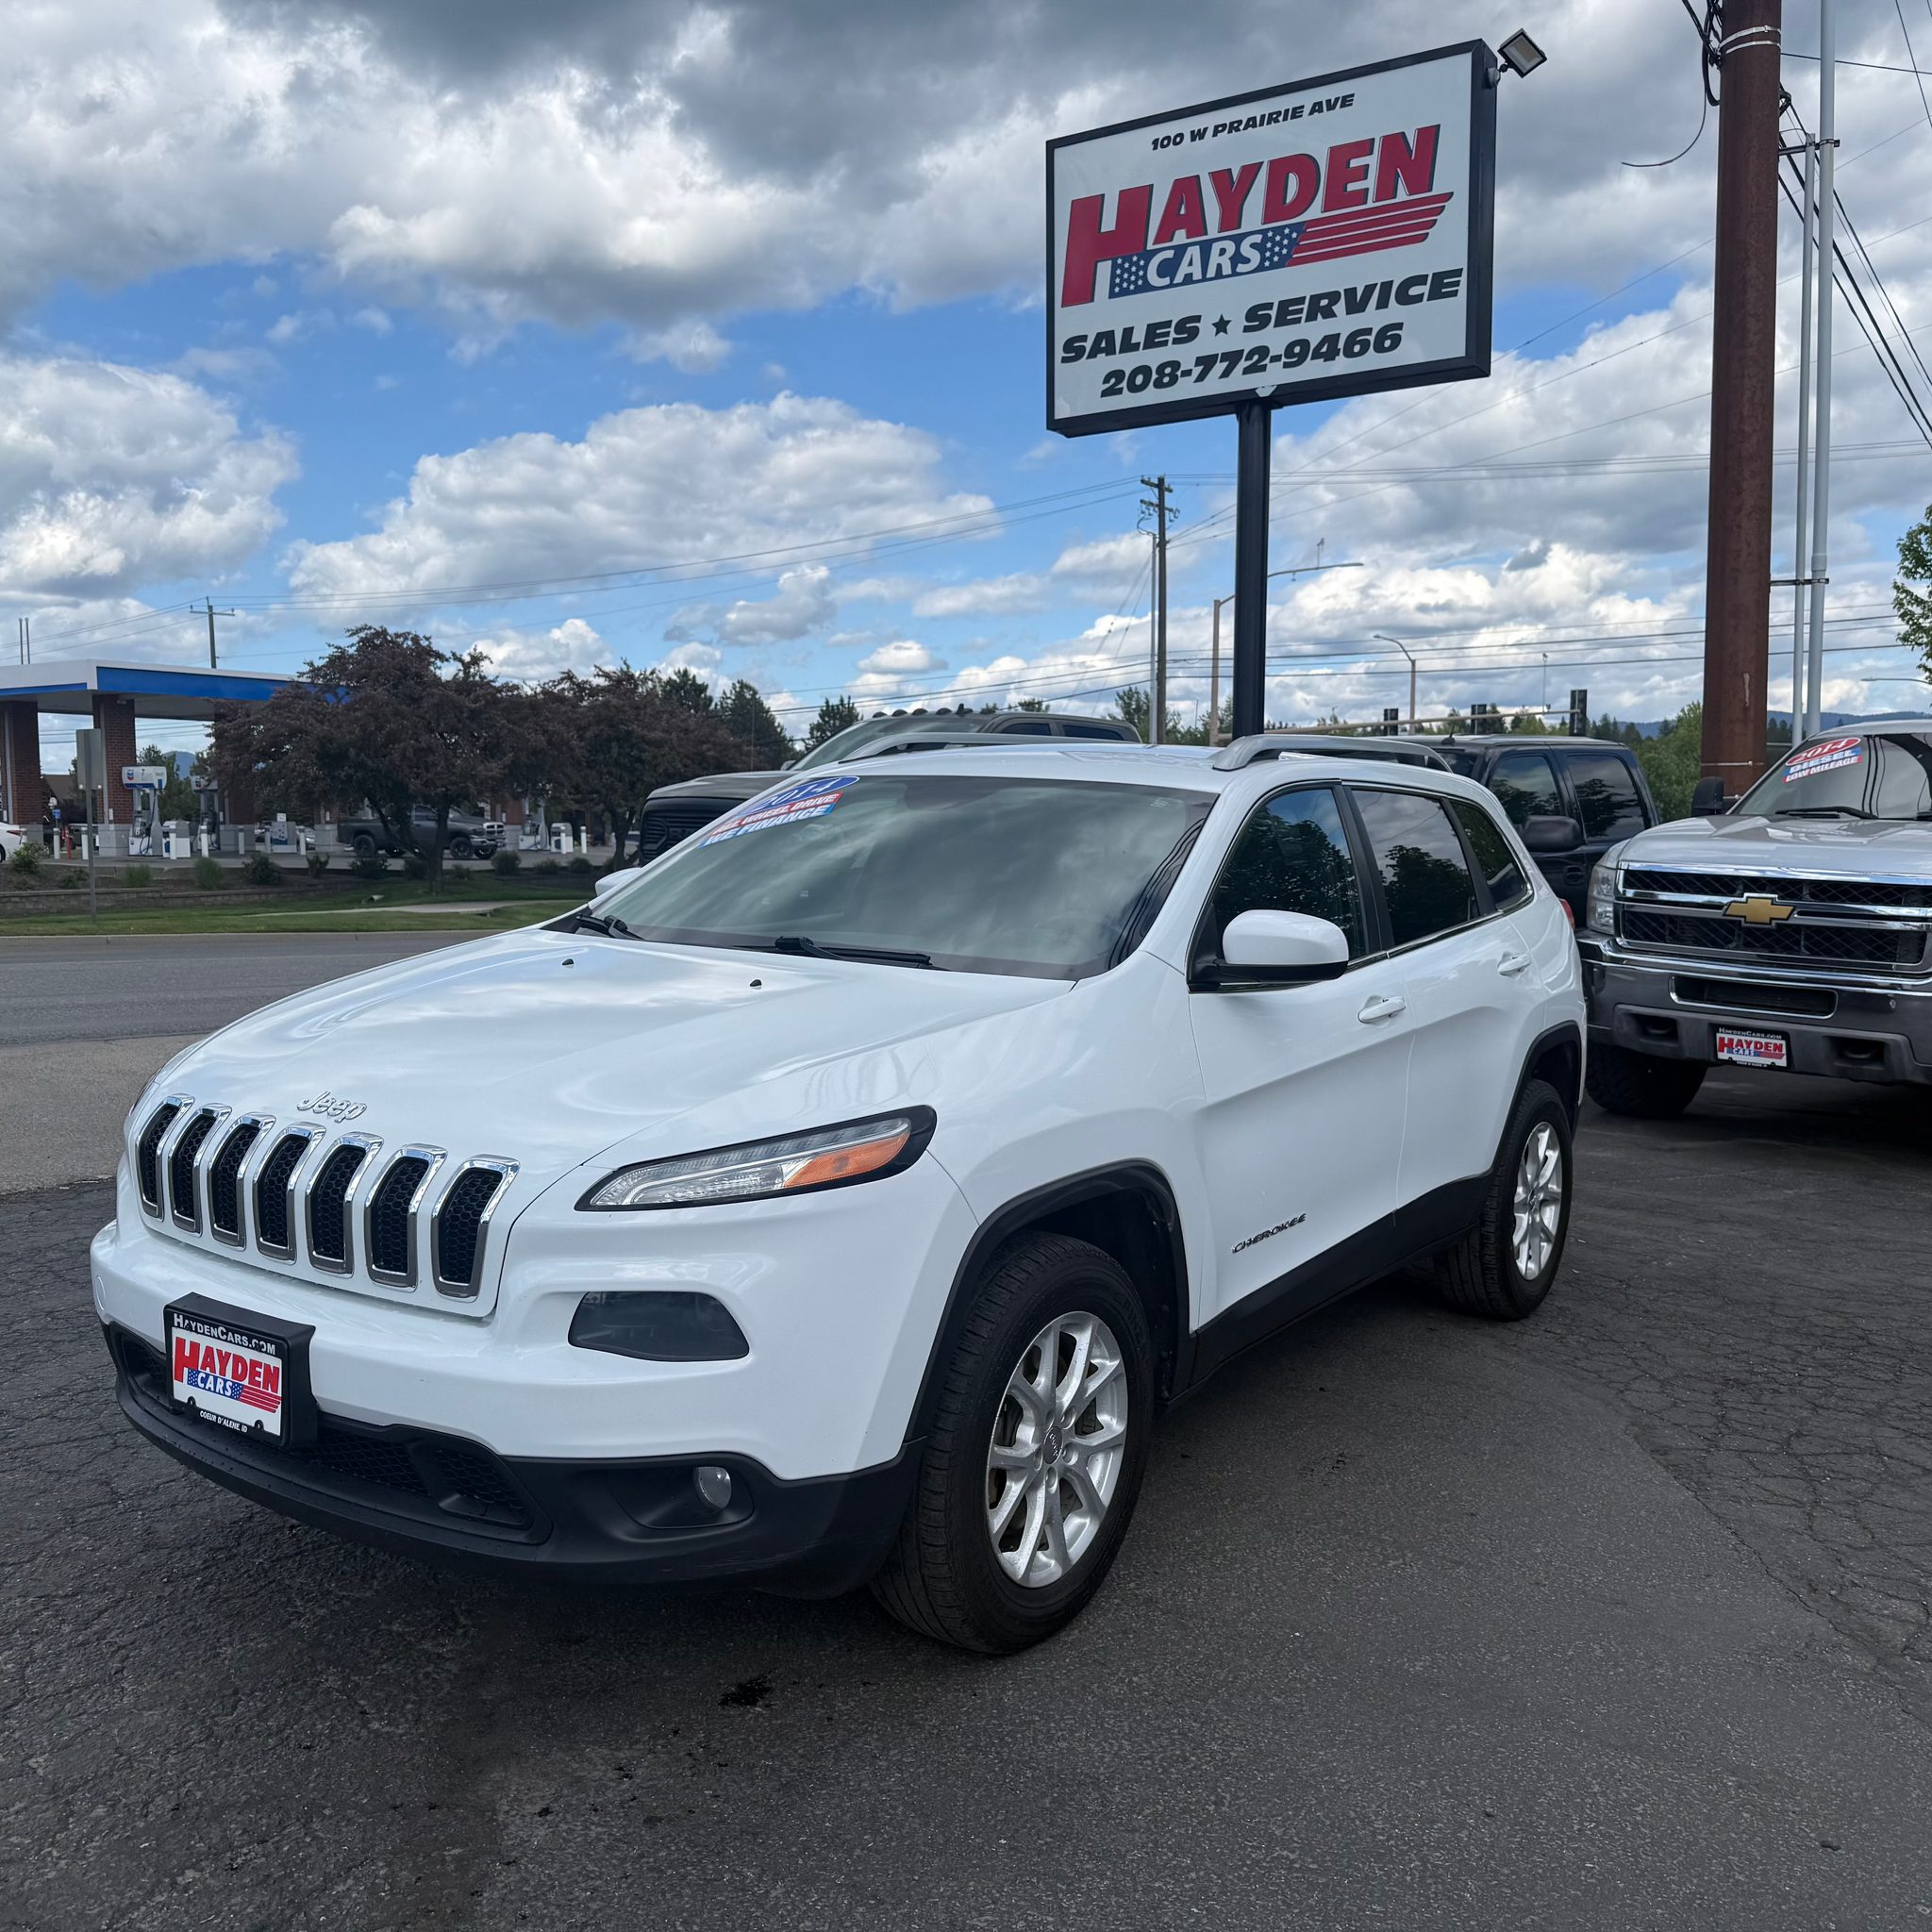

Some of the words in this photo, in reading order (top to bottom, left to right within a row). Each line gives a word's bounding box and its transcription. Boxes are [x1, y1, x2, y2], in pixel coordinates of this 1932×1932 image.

[1151, 130, 1185, 151] 100
[1189, 125, 1209, 142] W
[1212, 105, 1307, 138] PRAIRIE
[1308, 93, 1356, 116] AVE
[1061, 124, 1441, 308] HAYDEN
[1146, 233, 1264, 288] CARS
[1060, 314, 1202, 364] SALES
[1242, 268, 1464, 334] SERVICE
[1100, 322, 1404, 398] 208-772-9466
[1789, 749, 1857, 774] DIESEL
[1793, 739, 1848, 762] 2014
[1785, 769, 1810, 782] LOW
[1810, 756, 1857, 774] MILEAGE
[791, 793, 840, 811] DRIVE
[736, 804, 830, 837] FINANCE
[1718, 1037, 1783, 1053] HAYDEN
[1733, 1048, 1755, 1057] CARS
[296, 1091, 368, 1124] Jeep
[1231, 1212, 1307, 1254] CHEROKEE
[174, 1336, 280, 1394] HAYDEN
[197, 1372, 233, 1396] CARS
[200, 1410, 217, 1423] COEUR
